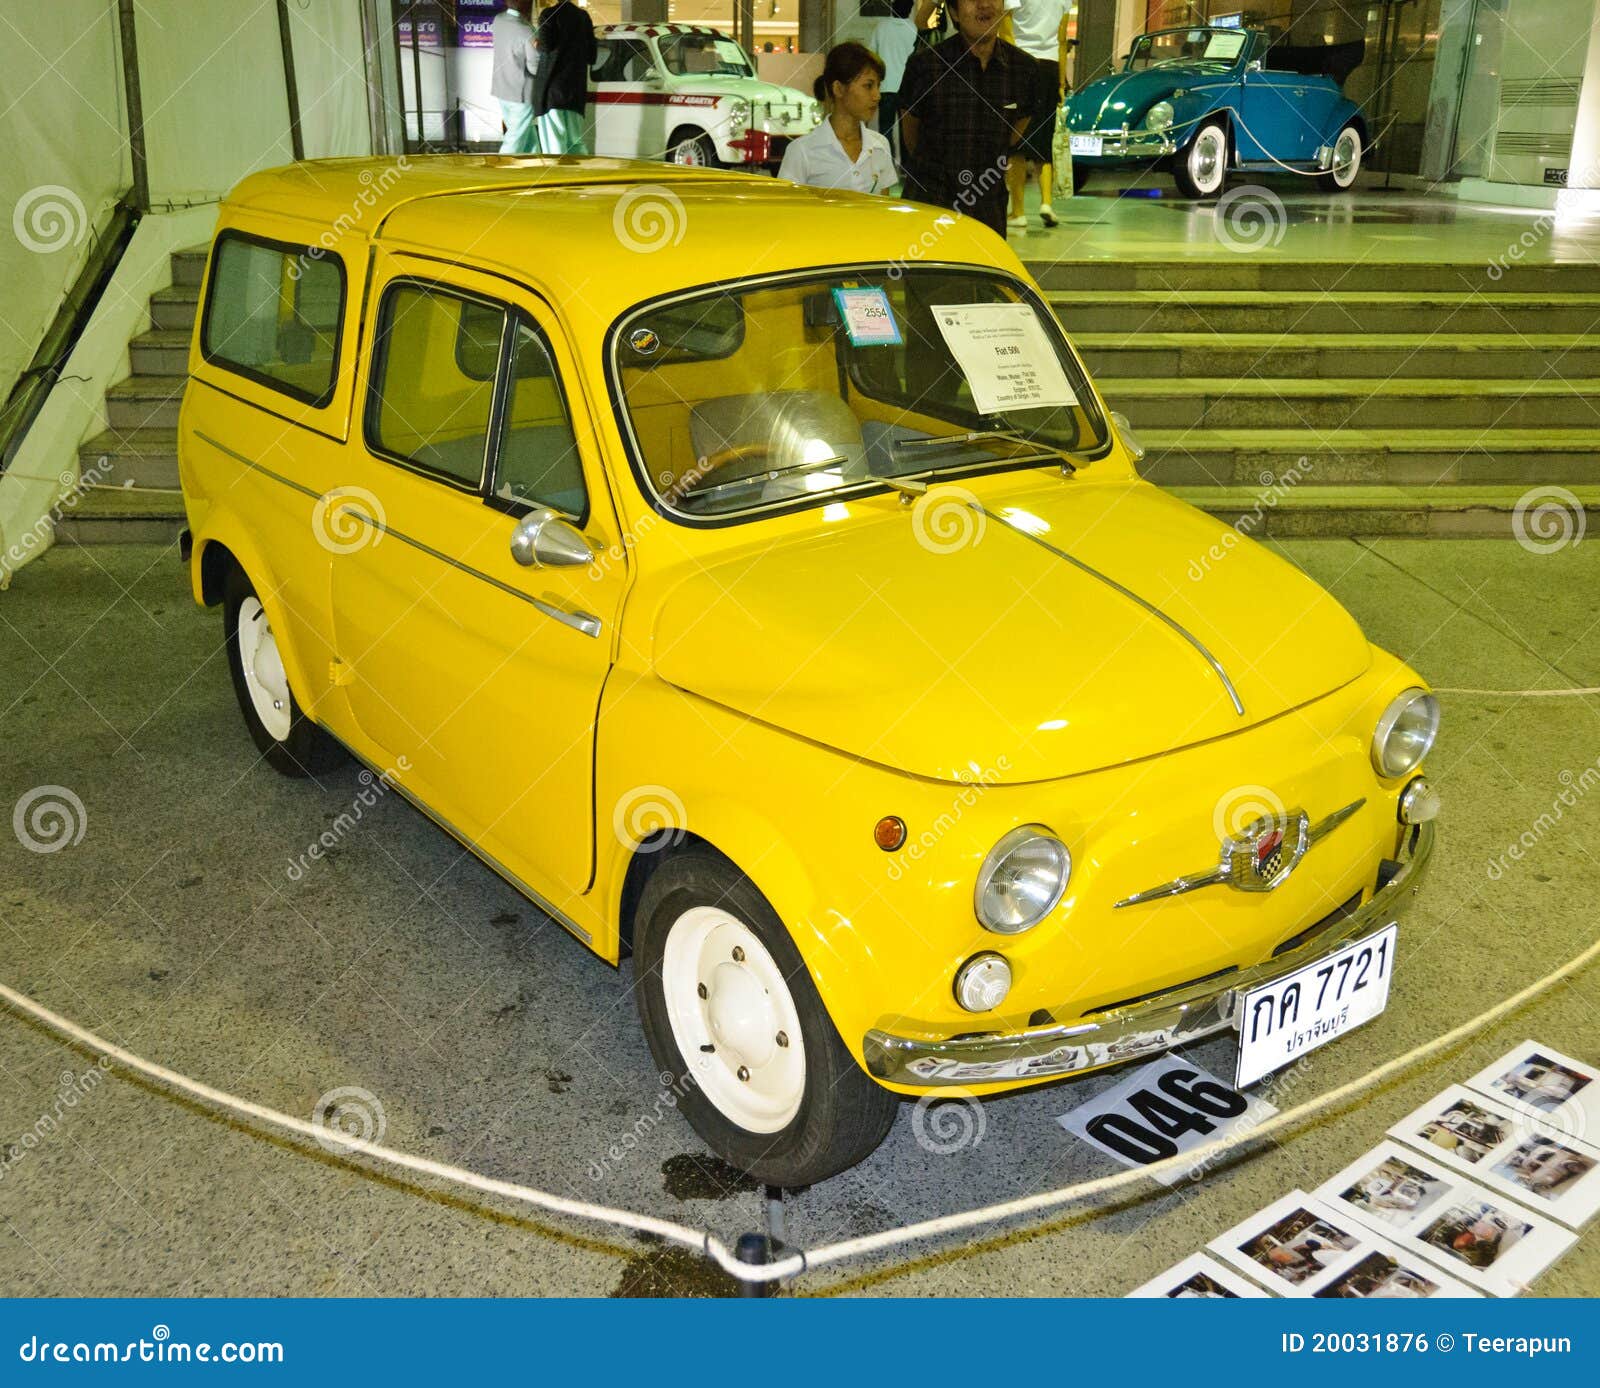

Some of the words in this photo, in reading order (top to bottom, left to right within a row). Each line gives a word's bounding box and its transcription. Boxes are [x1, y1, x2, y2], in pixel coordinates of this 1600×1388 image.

[864, 307, 887, 318] 2554
[1316, 937, 1387, 1012] 7721
[1085, 1069, 1248, 1165] 046
